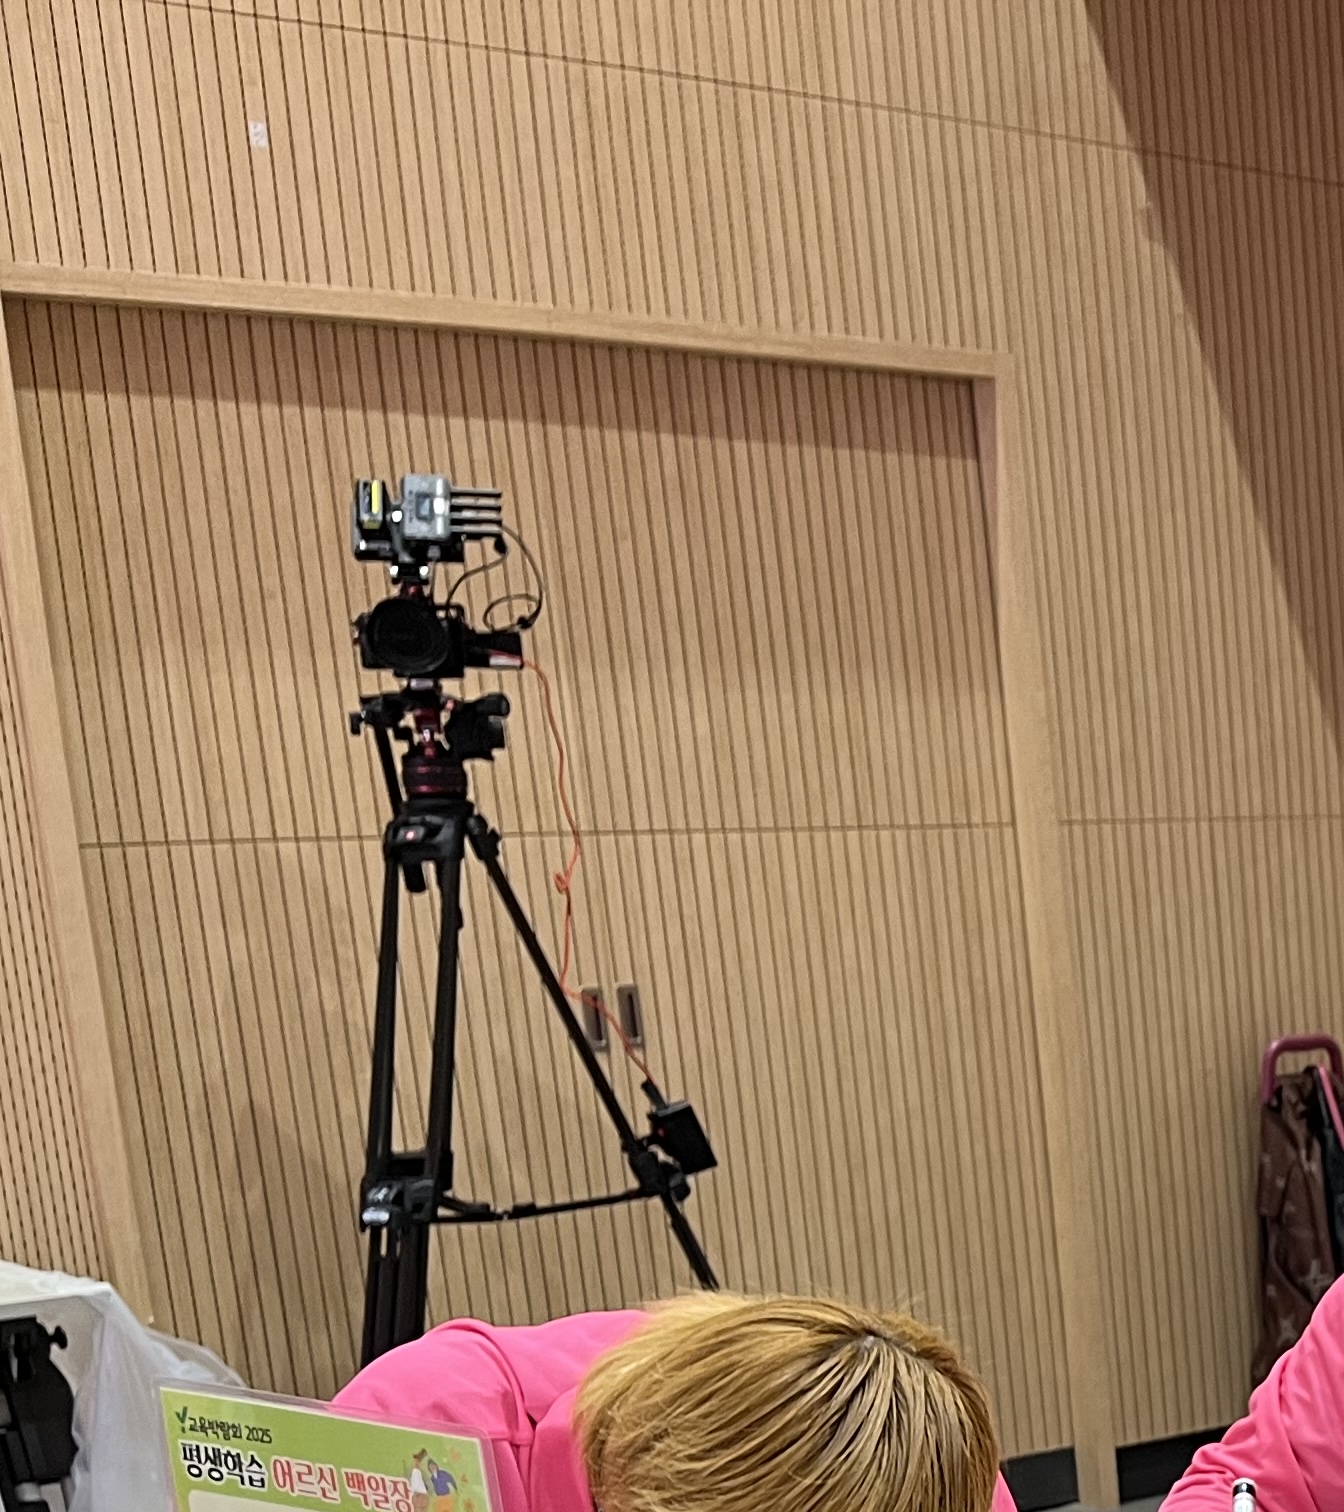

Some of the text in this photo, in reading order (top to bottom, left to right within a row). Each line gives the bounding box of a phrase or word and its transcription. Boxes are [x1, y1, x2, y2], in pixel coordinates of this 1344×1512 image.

[187, 1417, 273, 1444] 교육박람회 2025
[180, 1441, 267, 1490] 평생학습
[272, 1458, 341, 1502] 어르신
